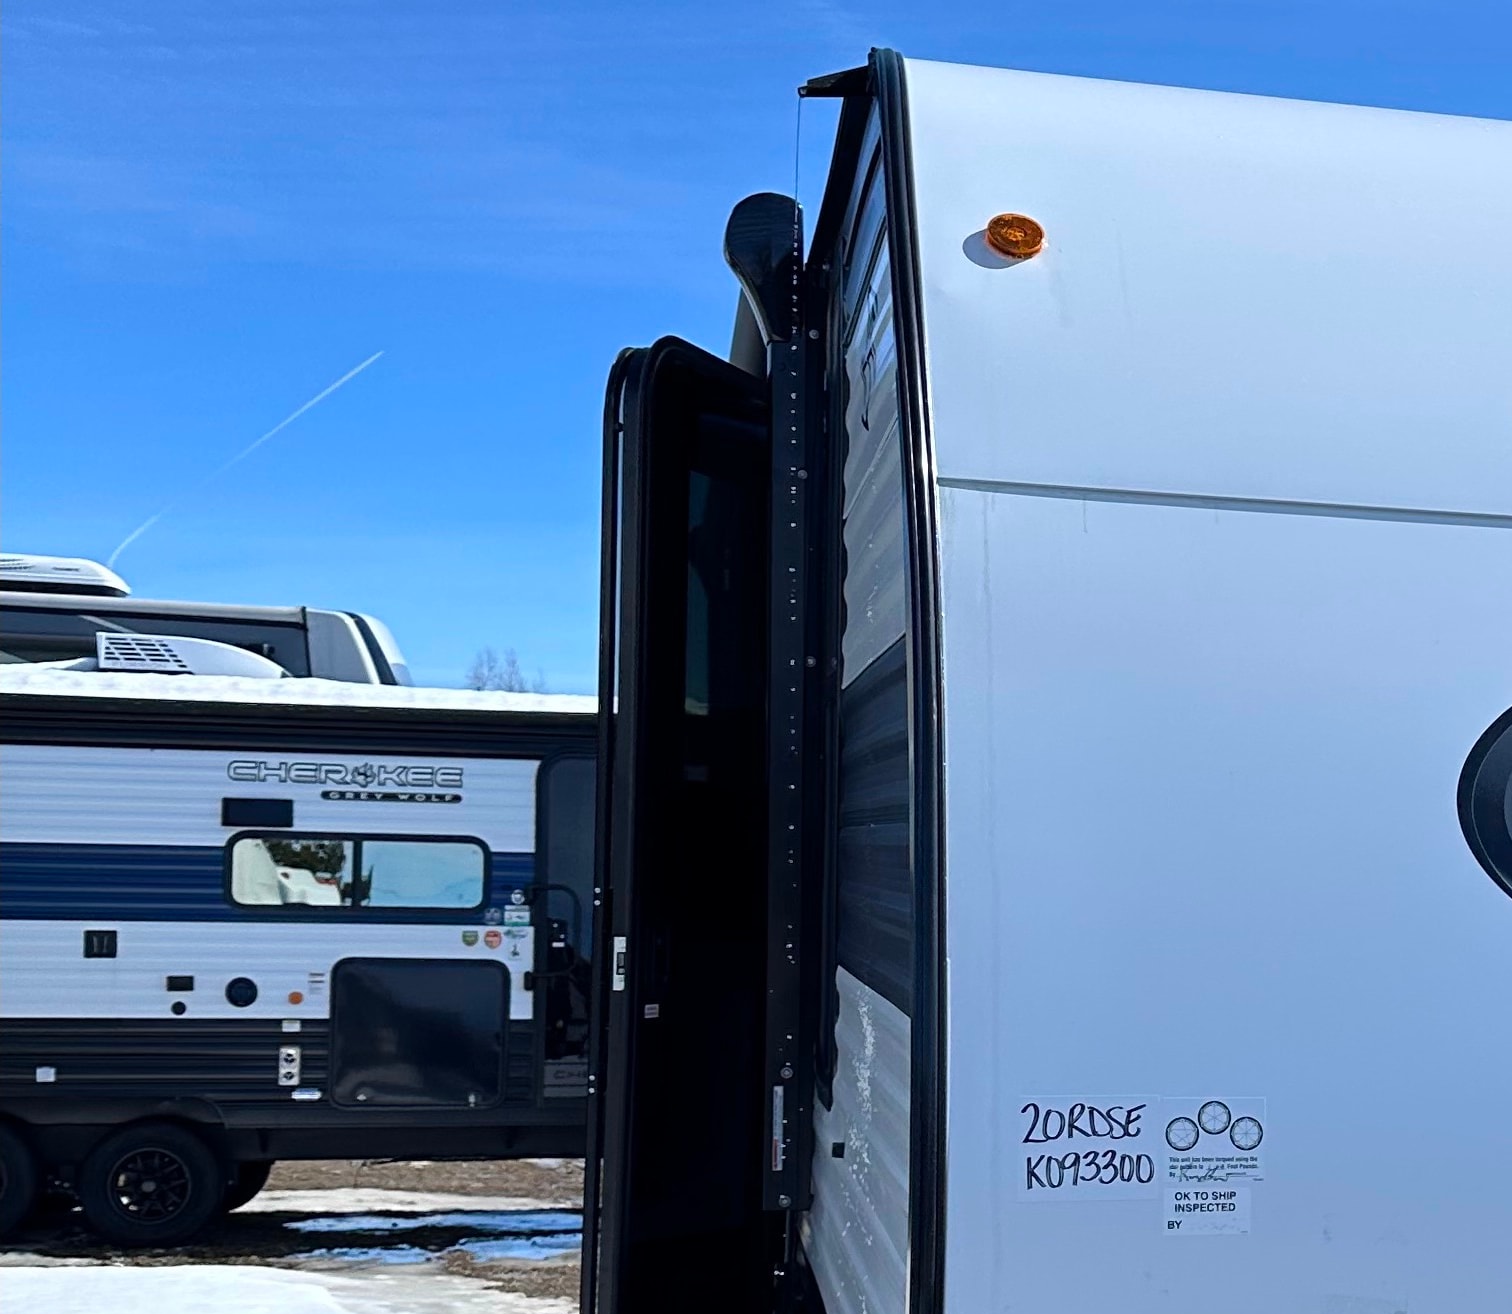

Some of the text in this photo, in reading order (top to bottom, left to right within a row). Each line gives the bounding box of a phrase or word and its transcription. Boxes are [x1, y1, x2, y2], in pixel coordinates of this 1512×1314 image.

[329, 791, 453, 802] GREY WOLF
[1020, 1102, 1147, 1144] 20RDSE
[1026, 1149, 1155, 1190] K093300
[1174, 1191, 1237, 1201] OK TO SHIP
[1174, 1202, 1236, 1212] INSPECTED
[1167, 1220, 1182, 1229] BY
